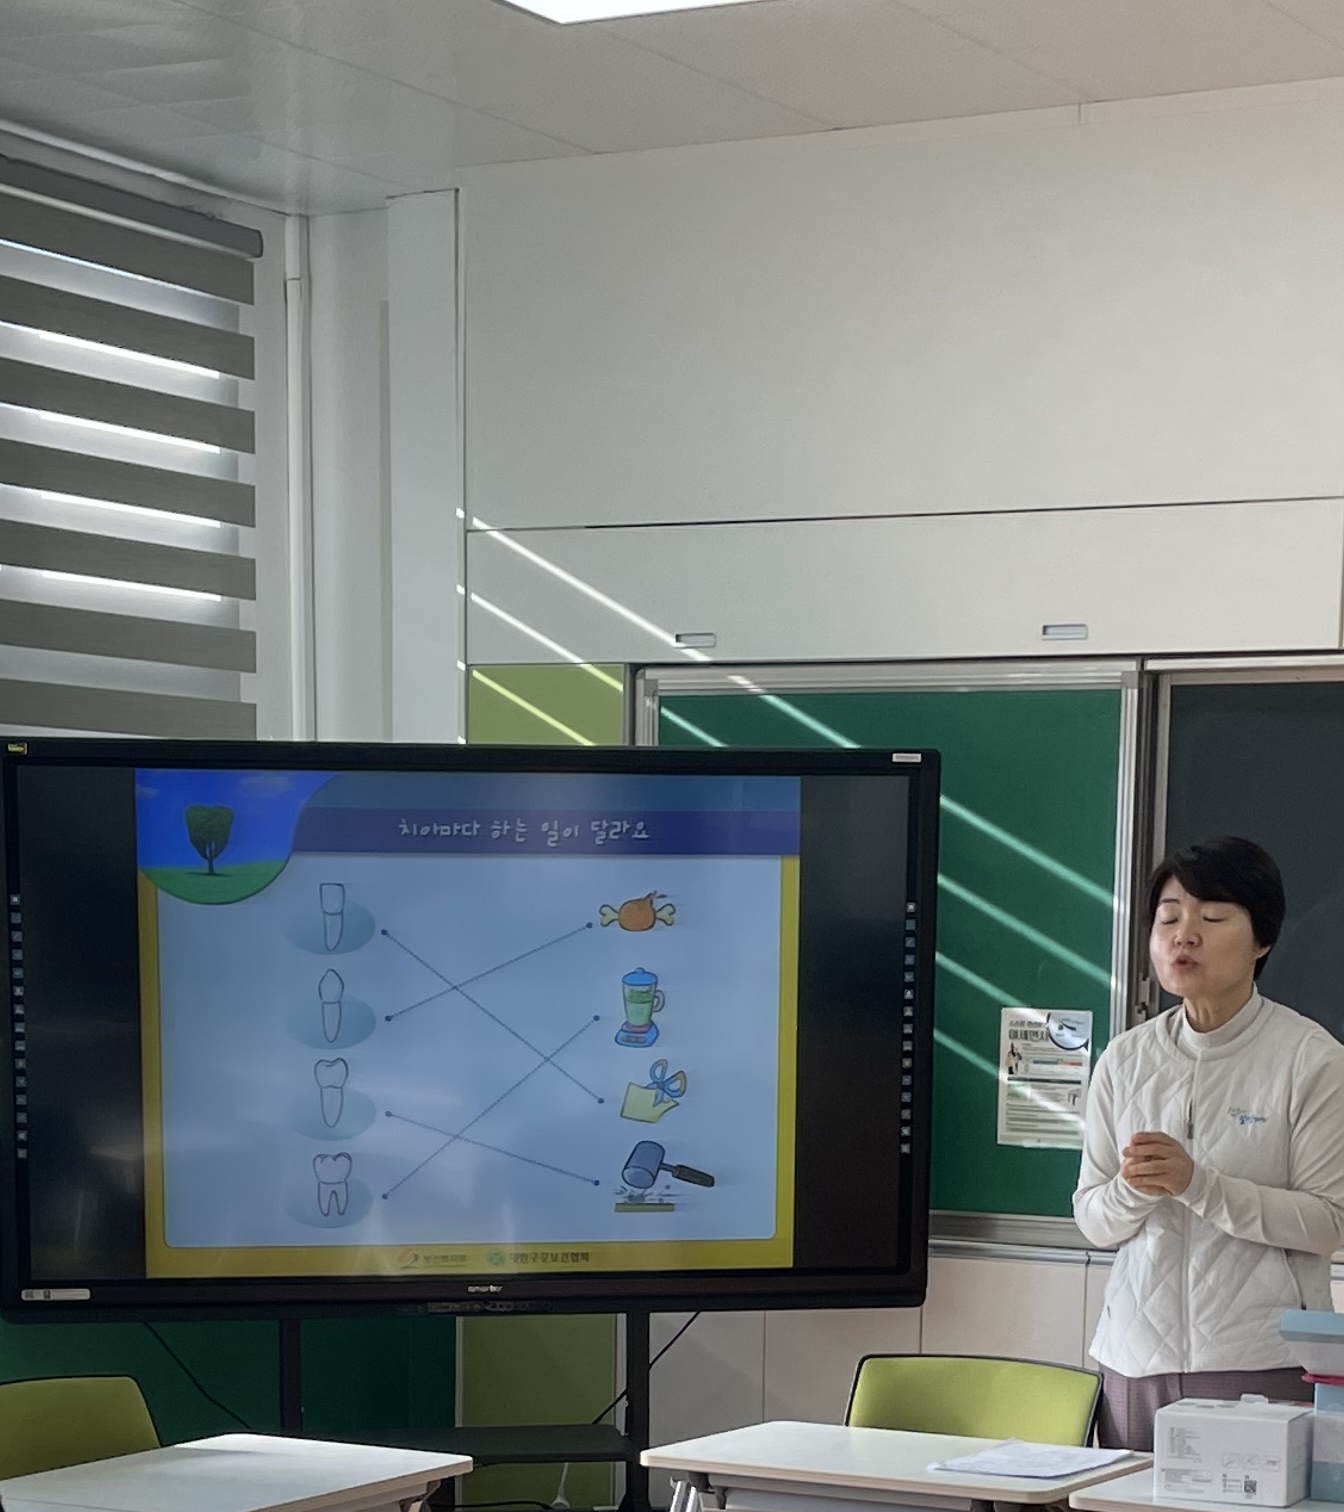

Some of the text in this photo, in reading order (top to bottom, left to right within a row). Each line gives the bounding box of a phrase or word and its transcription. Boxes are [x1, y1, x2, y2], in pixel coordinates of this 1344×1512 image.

[399, 818, 650, 847] 치아마다 하는 일이 달라요
